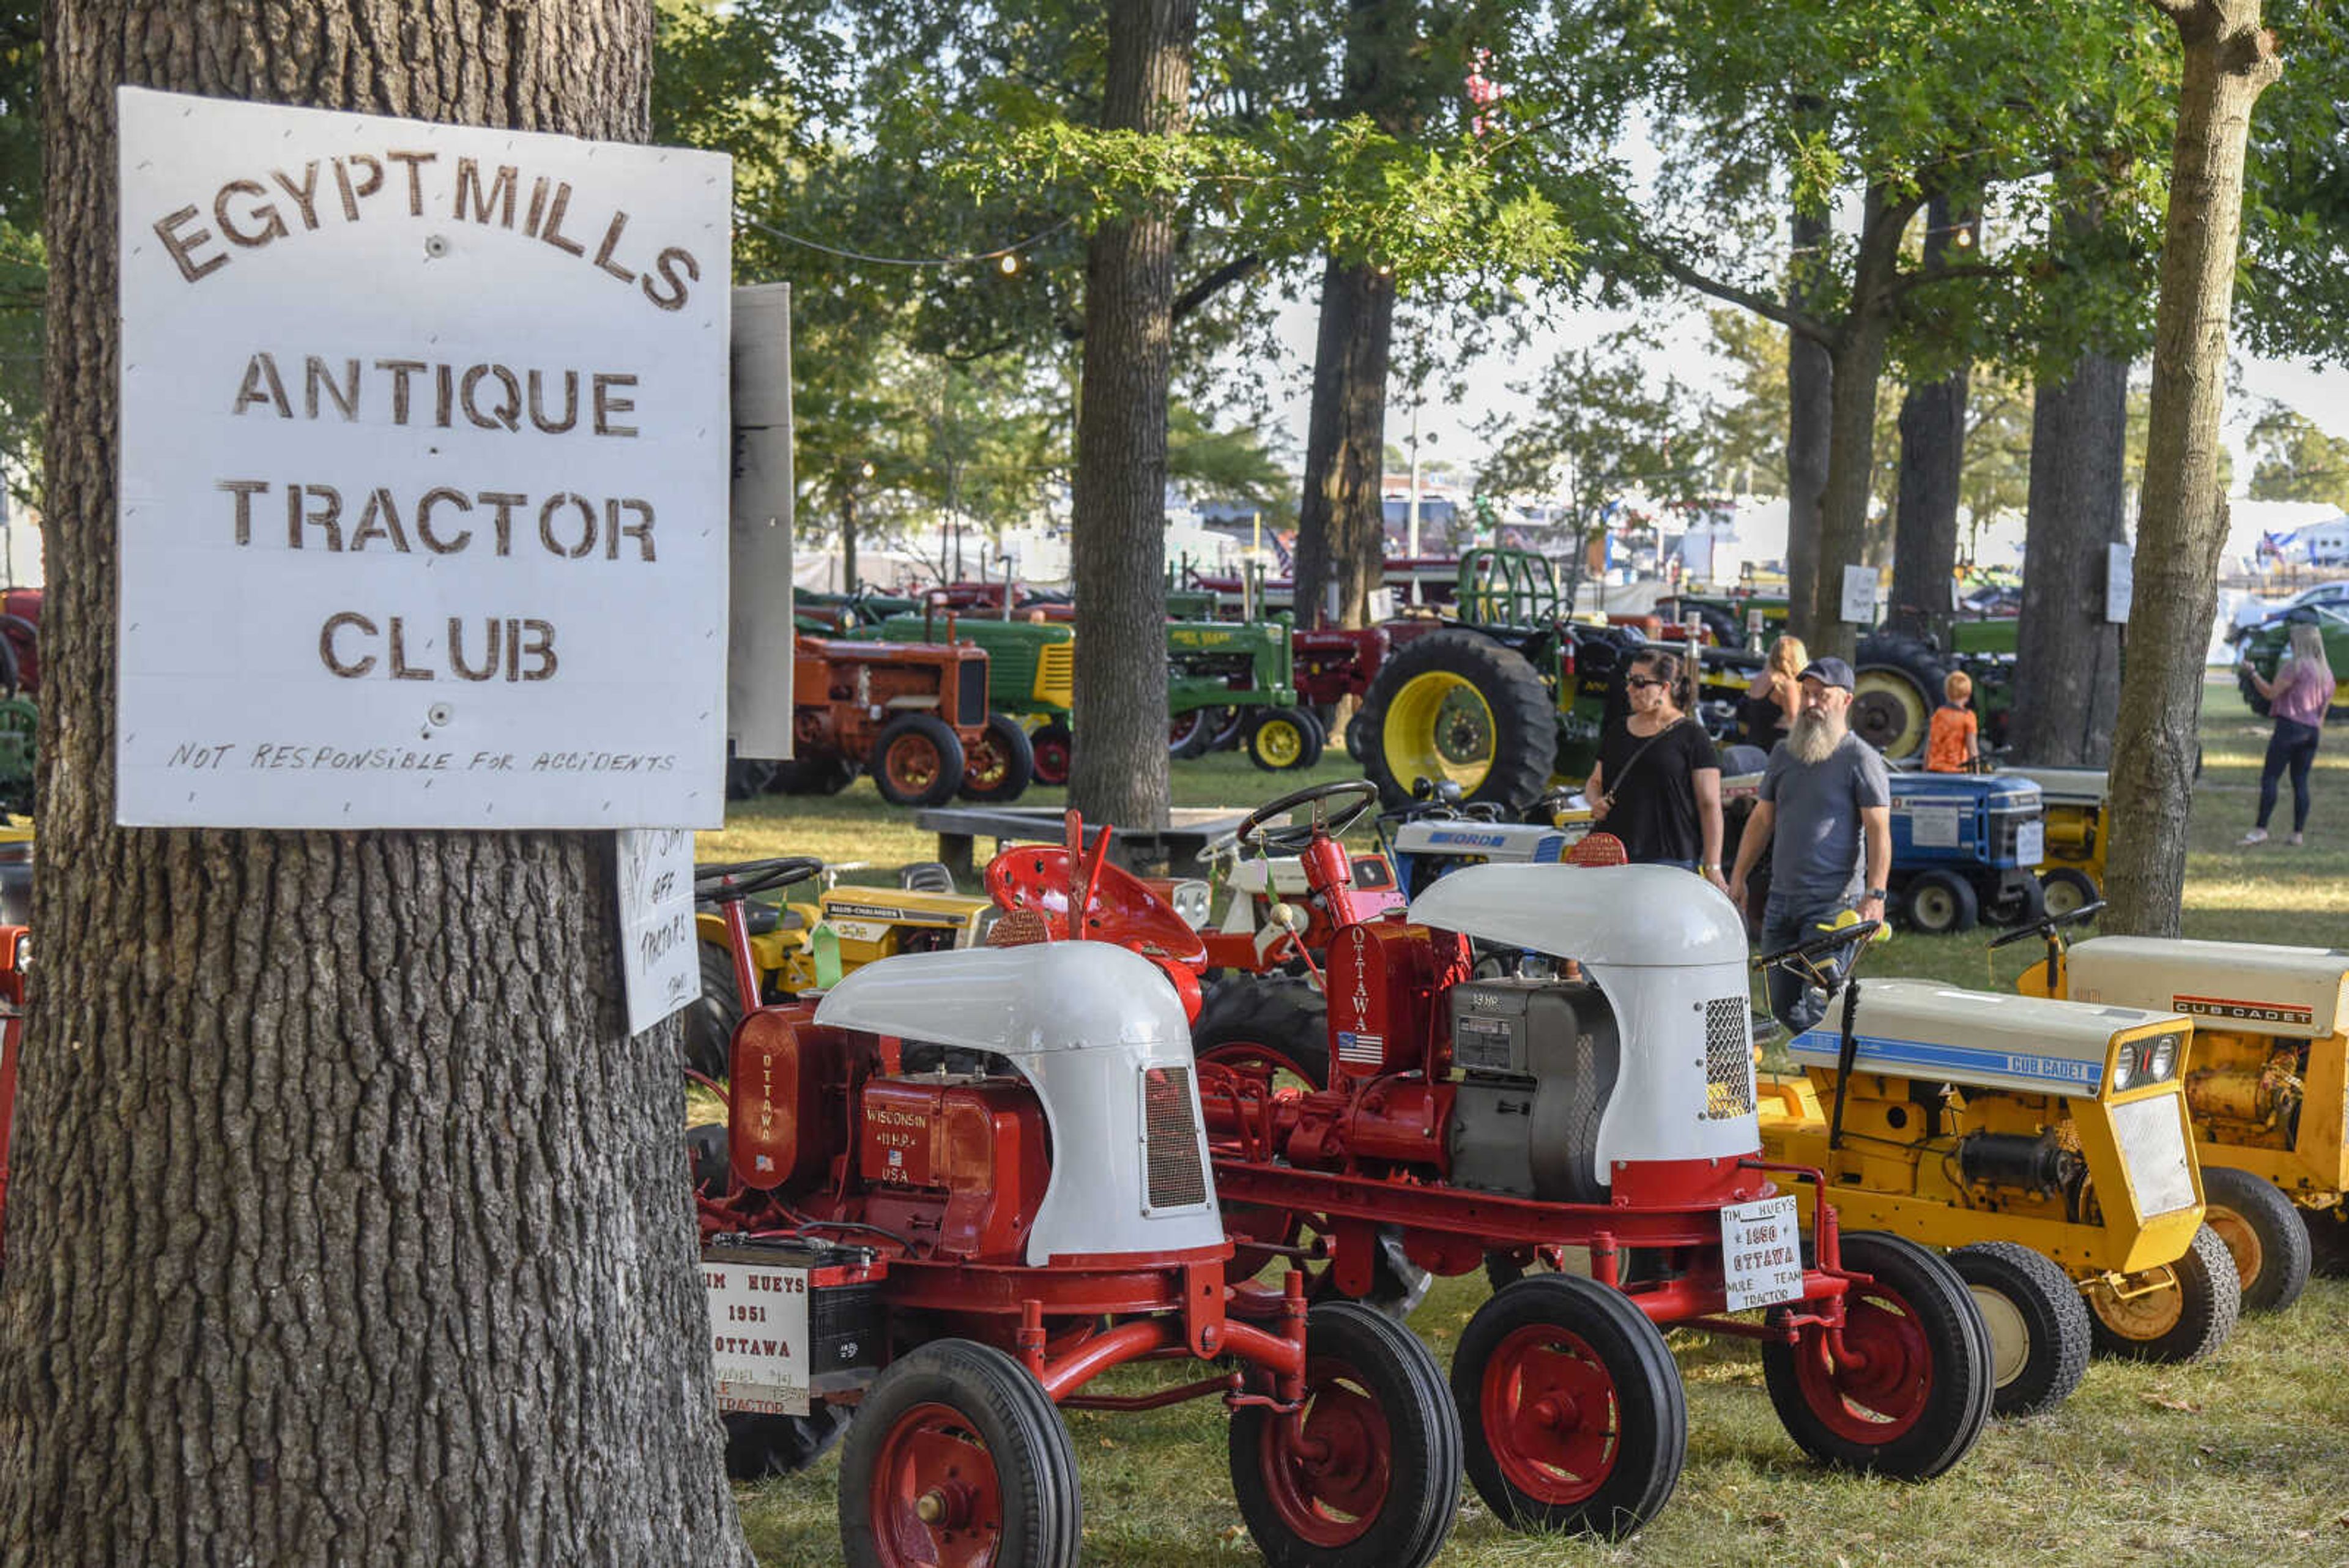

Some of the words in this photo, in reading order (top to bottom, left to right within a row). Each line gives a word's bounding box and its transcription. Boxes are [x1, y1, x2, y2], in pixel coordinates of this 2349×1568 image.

[152, 150, 439, 284] EGYPT
[452, 156, 699, 312] MILLS
[232, 352, 639, 438] ANTIQUE
[216, 480, 658, 562] TRACTOR
[319, 612, 559, 683] CLUB
[168, 742, 236, 769] NOT
[467, 751, 514, 771] FOR
[1352, 926, 1370, 1032] OTTAWA
[2175, 1002, 2223, 1014] CUB
[2232, 1008, 2311, 1023] CADET
[2012, 1055, 2038, 1073] CUB
[2043, 1059, 2085, 1080] CADET
[761, 1054, 774, 1141] OTTAWA
[867, 1109, 927, 1129] WISCONSIN
[1723, 1209, 1741, 1223] TIM
[1734, 1246, 1795, 1272] OTTAWA
[703, 1272, 726, 1290] IM
[748, 1274, 804, 1293] HUEYS
[1773, 1270, 1802, 1285] TEAM
[1743, 1288, 1789, 1308] TRACTOR
[729, 1304, 766, 1322] 1951
[715, 1336, 791, 1358] OTTAWA
